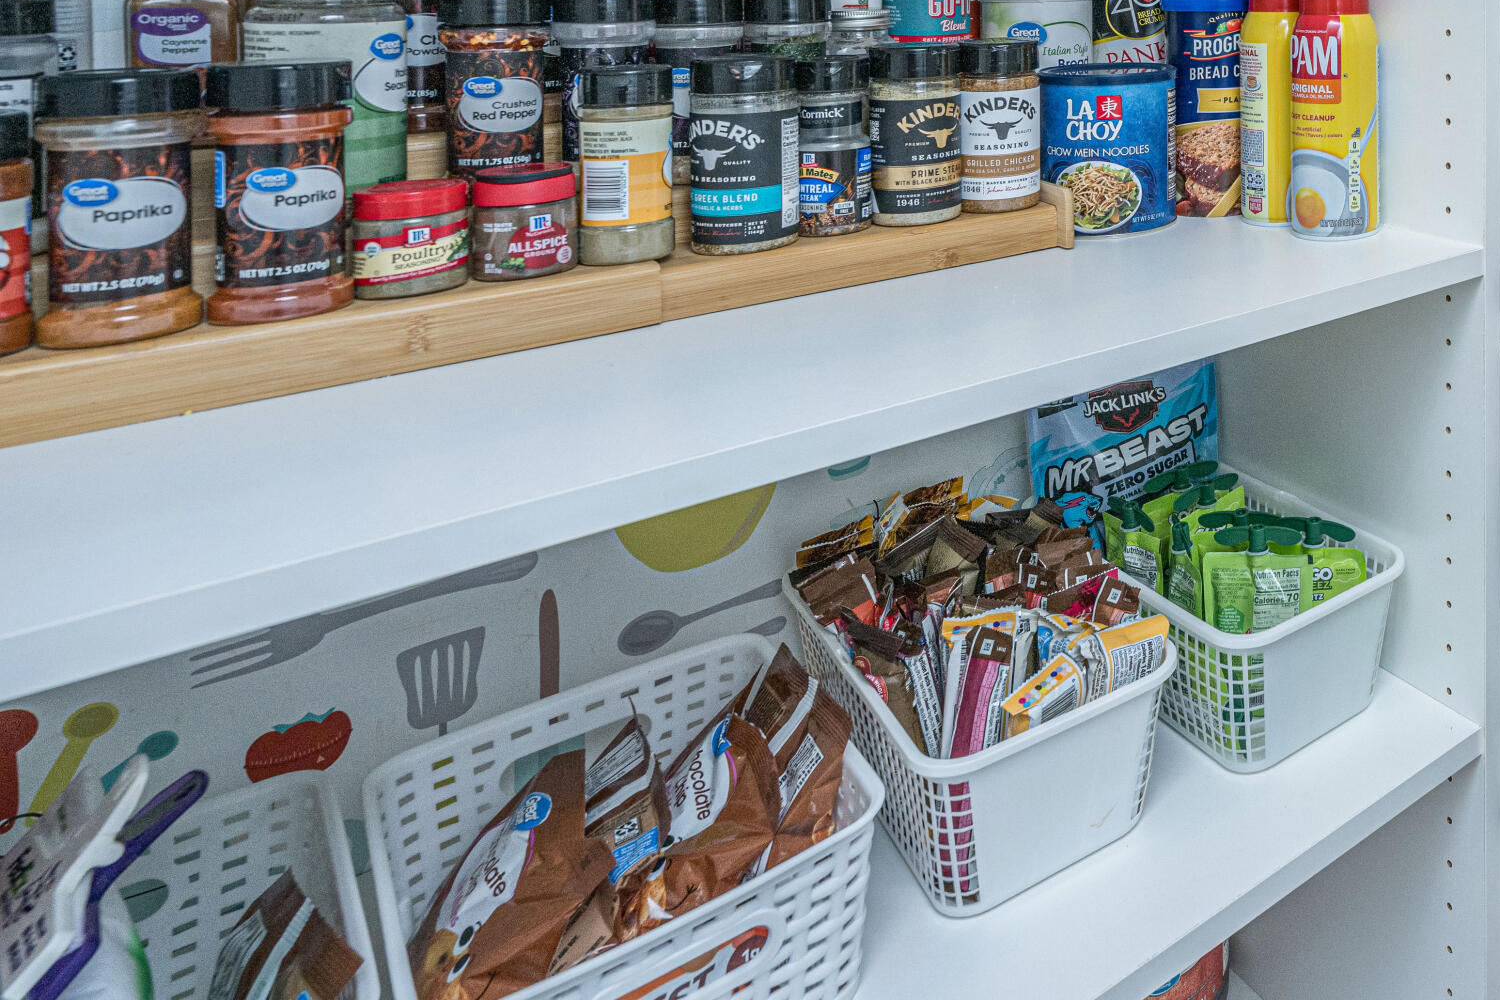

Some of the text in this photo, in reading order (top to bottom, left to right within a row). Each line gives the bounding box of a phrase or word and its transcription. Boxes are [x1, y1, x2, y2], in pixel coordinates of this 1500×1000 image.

[137, 12, 199, 27] Organic
[941, 19, 967, 32] Blend
[1010, 27, 1040, 38] Great
[161, 38, 208, 48] Cayenne
[161, 47, 200, 56] Pepper
[1042, 44, 1070, 57] Italian
[1290, 34, 1338, 76] PAM
[1190, 67, 1229, 81] BREAD
[468, 81, 496, 91] Great
[1291, 83, 1332, 94] ORIGINAL
[492, 99, 537, 110] Crushed
[964, 97, 1036, 122] KINDER'S
[1067, 99, 1095, 121] LA
[472, 108, 537, 121] Red Pepper
[1302, 114, 1335, 122] CLEANUP
[1066, 119, 1123, 142] CHOY
[974, 141, 1029, 151] SEASONING
[1047, 145, 1150, 157] CHOW MEIN NOODLES
[967, 155, 1035, 167] GRILLED CHICKEN
[701, 175, 756, 183] SEASONING
[806, 168, 835, 180] Mates
[911, 168, 940, 179] PRIME
[912, 178, 933, 186] BLACK
[274, 190, 337, 207] Paprika
[722, 193, 758, 203] BLEND
[896, 199, 920, 207] 1946
[92, 204, 173, 224] Paprika
[508, 235, 568, 254] ALLSPICE
[391, 243, 449, 264] Poultry
[394, 258, 441, 269] SEASONING
[1084, 387, 1166, 418] JACK LINK'S
[1094, 405, 1207, 478] BEAST
[1105, 449, 1188, 496] ZERO SUGAR
[1287, 593, 1299, 602] 70
